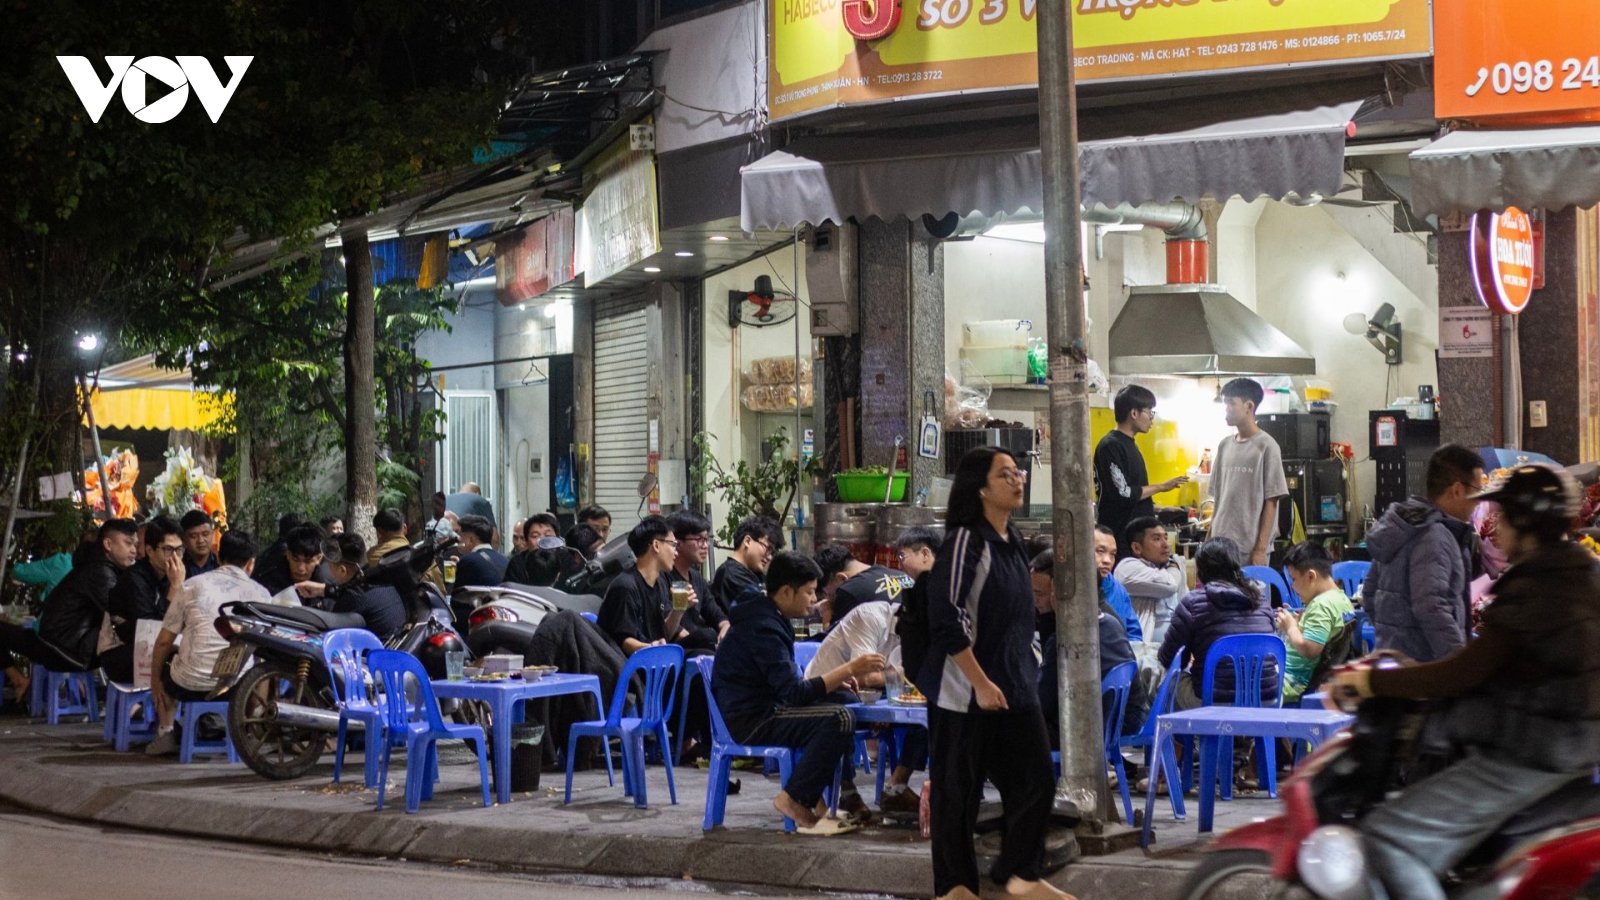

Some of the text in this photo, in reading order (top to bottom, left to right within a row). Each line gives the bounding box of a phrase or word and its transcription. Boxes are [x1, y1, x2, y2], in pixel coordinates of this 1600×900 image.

[1098, 52, 1135, 64] TRADING
[1157, 49, 1171, 60] CK:
[1173, 47, 1190, 58] HAT
[1197, 46, 1215, 56] TEL:
[1216, 43, 1239, 55] 0243
[1240, 41, 1256, 52] 728
[1258, 40, 1278, 51] 1476
[1284, 38, 1301, 49] MS:
[1302, 35, 1340, 47] 0124866
[1346, 33, 1361, 44] PT:
[1362, 29, 1406, 42] 1065.7/24
[857, 76, 869, 86] HN
[912, 72, 921, 81] 28
[923, 69, 943, 80] 3722
[1492, 56, 1600, 94] 098 24
